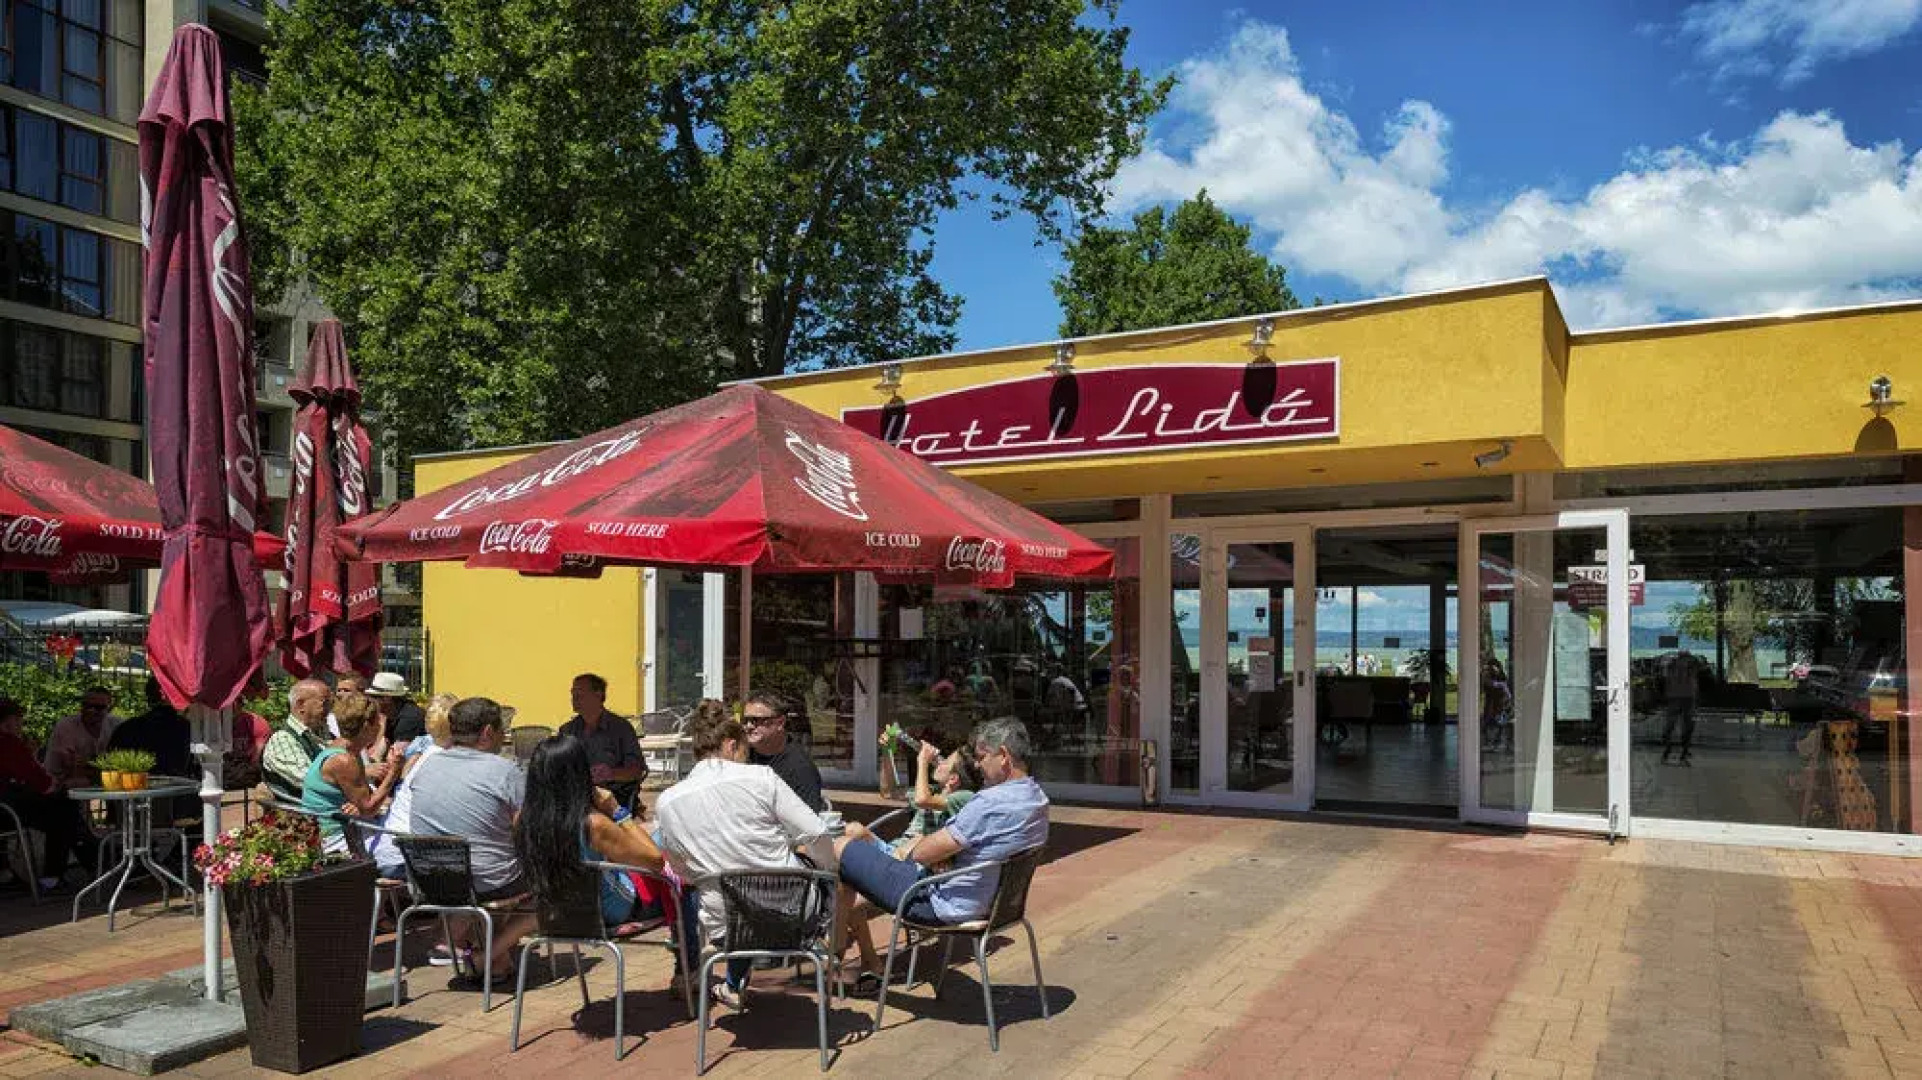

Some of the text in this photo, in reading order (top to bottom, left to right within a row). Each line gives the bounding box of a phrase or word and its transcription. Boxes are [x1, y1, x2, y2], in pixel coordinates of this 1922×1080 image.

[100, 523, 143, 539] SOLD
[410, 524, 462, 541] ICE COLD
[584, 522, 669, 538] SOLD HERE
[865, 532, 921, 548] ICE COLD
[1573, 569, 1639, 580] STRD
